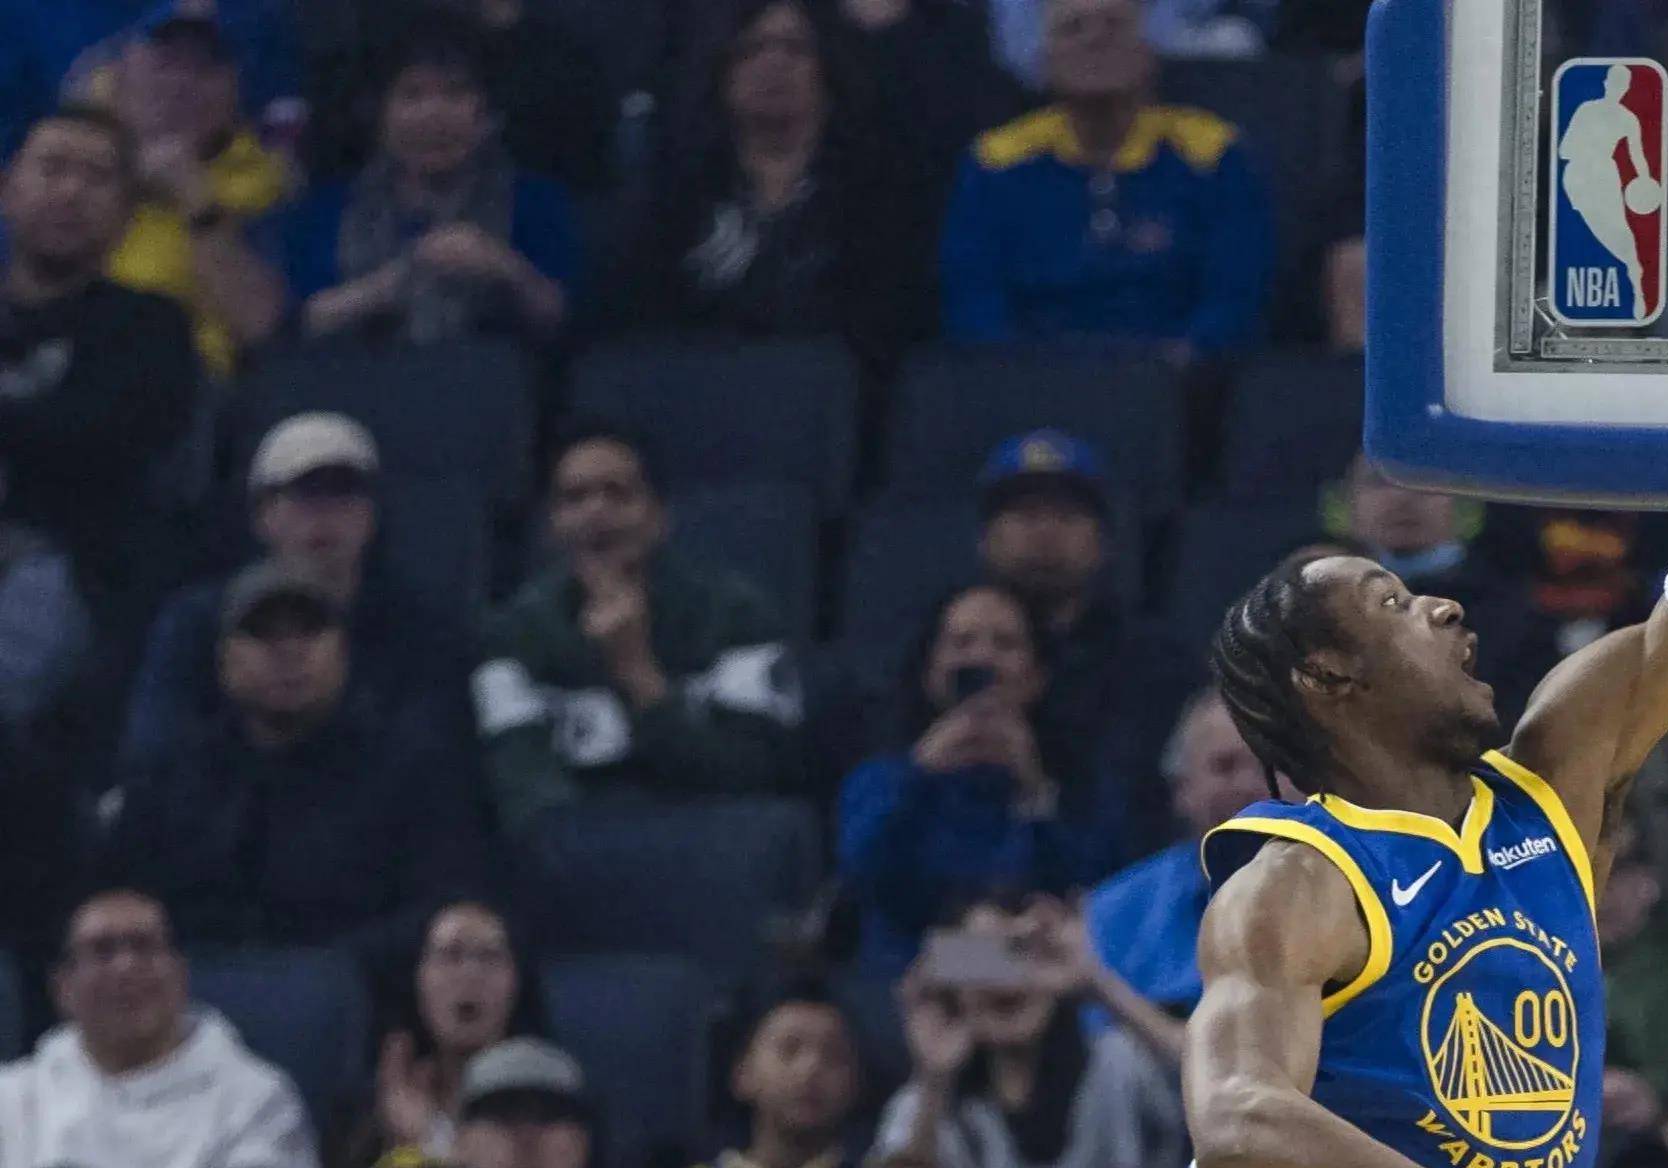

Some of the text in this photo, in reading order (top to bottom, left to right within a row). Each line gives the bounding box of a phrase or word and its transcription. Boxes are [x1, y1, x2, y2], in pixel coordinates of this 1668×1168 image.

[1566, 266, 1621, 308] NBA
[1413, 907, 1578, 984] GOLDEN STATE
[1514, 989, 1567, 1048] 00
